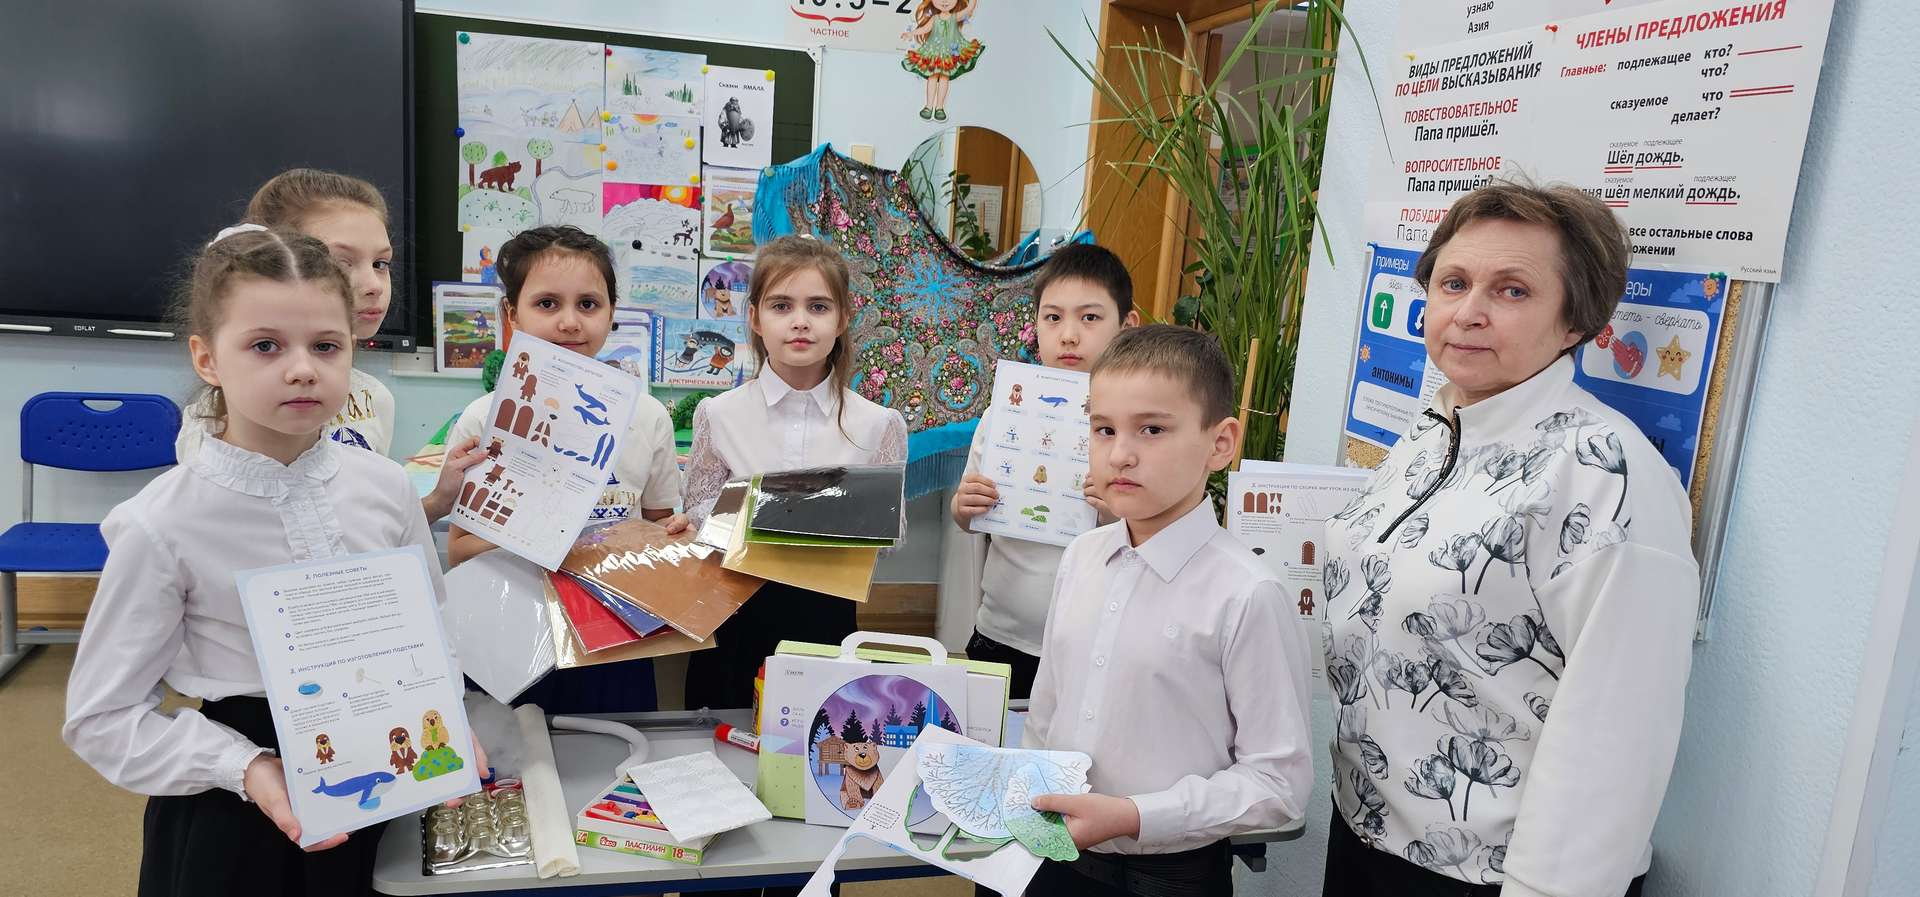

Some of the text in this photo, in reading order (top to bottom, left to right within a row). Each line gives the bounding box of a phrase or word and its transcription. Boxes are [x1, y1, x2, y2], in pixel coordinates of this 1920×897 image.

[1466, 1, 1494, 17] узнаю
[809, 27, 849, 38] ЧАСТНОЕ
[1468, 20, 1489, 34] Азия
[1576, 0, 1787, 49] ЧЛЕНЫ ПРЕДЛОЖЕНИЯ
[1409, 41, 1534, 79] ВИДЫ ПРЕДЛОЖЕНИЙ
[1561, 44, 1733, 78] Главные: подлежащее кто?
[1395, 62, 1542, 97] ПО ЦЕЛИ ВЫСКАЗЫВАНИЯ
[1701, 63, 1729, 79] что?
[1610, 91, 1723, 110] сказуемое что
[1404, 98, 1519, 124] ПОВЕСТВОВАТЕЛЬНОЕ
[1671, 107, 1721, 125] делает?
[1415, 119, 1499, 143] Папа пришёл.
[1405, 156, 1501, 174] ВОПРОСИТЕЛЬНОЕ
[1607, 150, 1685, 166] Шёл дождь.
[1407, 176, 1436, 192] Папа
[1693, 174, 1737, 183] подлежащее
[1605, 184, 1630, 199] шёл
[1632, 183, 1685, 199] мелкий
[1686, 186, 1741, 202] дождь.
[1400, 208, 1449, 224] ПОБУДИТ
[1629, 227, 1754, 241] все остальные слова
[1632, 244, 1676, 256] ожении
[1375, 254, 1410, 273] примеры
[1371, 366, 1415, 390] антонимы
[313, 569, 344, 579] ПОЛЕЗНЫЕ
[345, 566, 368, 574] СОВЕТЫ
[298, 660, 337, 673] ИНСТРУКЦИЯ
[392, 642, 424, 653] ПОДСТАВКИ
[624, 839, 666, 853] ПЛАСТИЛИН
[672, 848, 684, 858] 18
